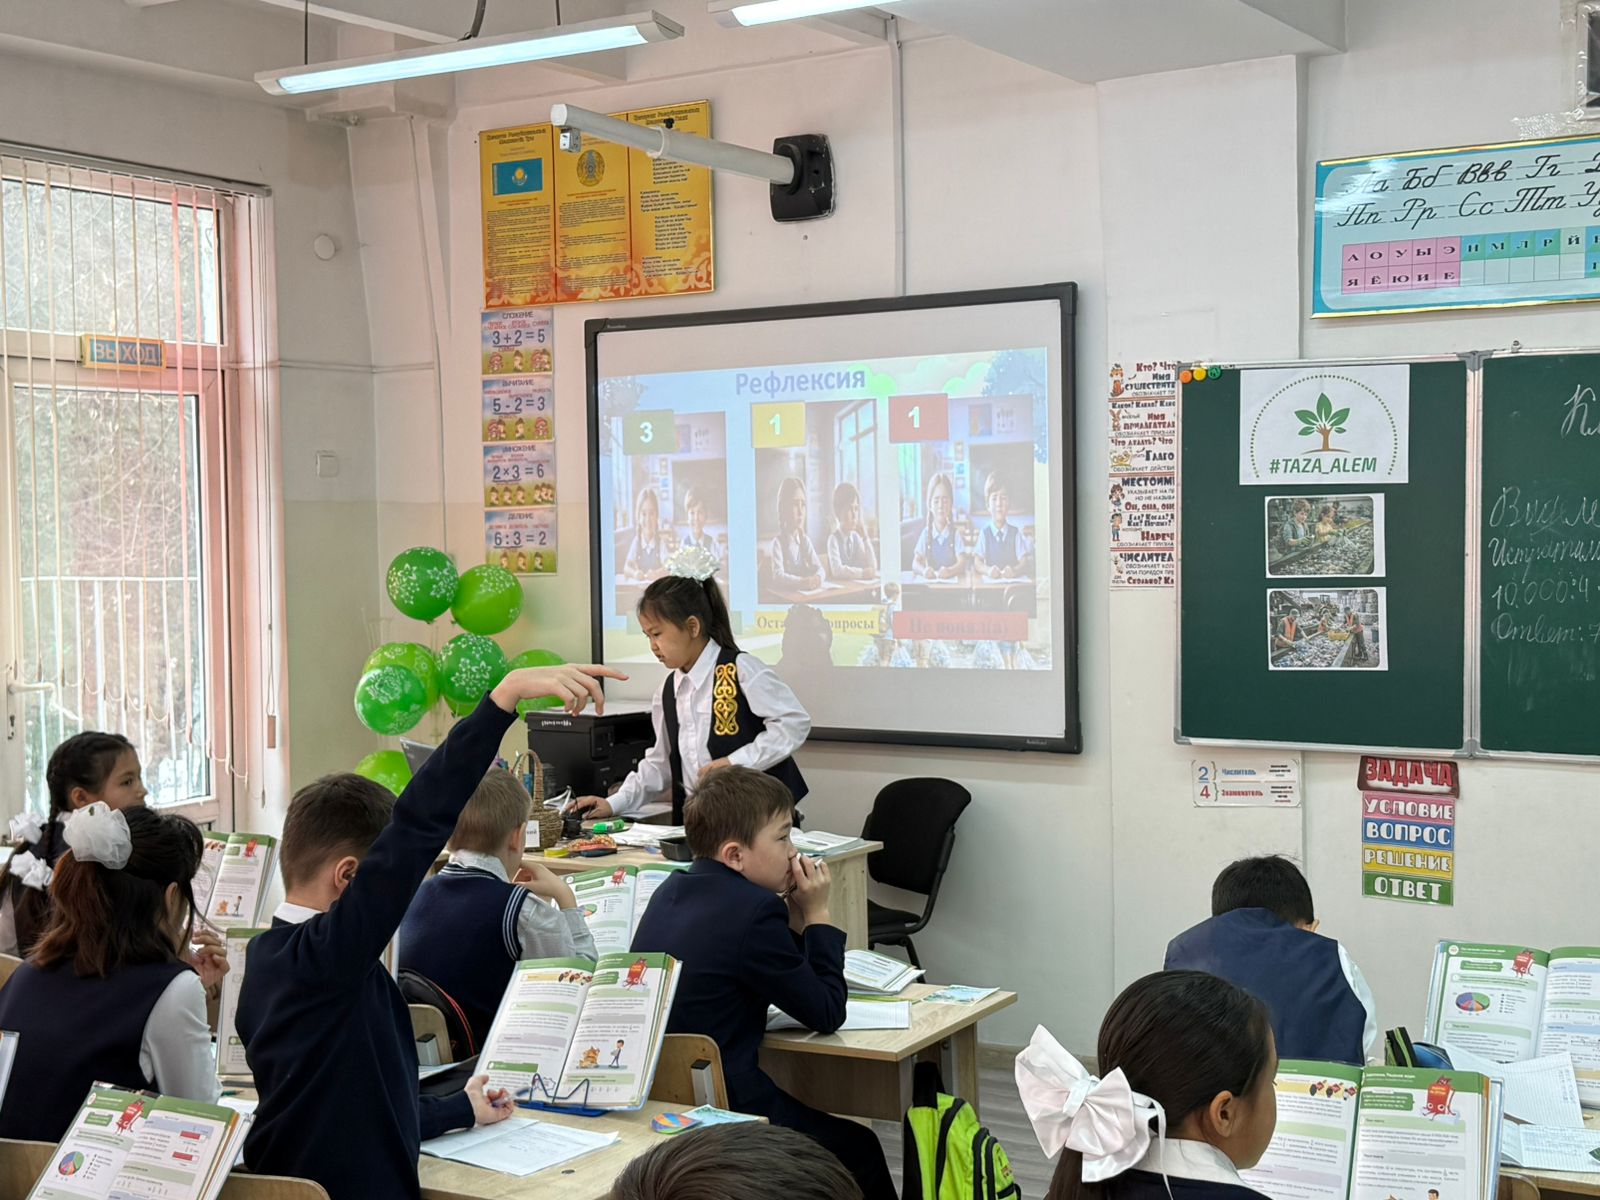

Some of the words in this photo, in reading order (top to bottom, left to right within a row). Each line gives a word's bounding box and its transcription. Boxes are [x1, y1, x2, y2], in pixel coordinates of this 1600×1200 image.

[1459, 191, 1494, 217] Сс
[1504, 185, 1566, 212] Тт
[1347, 253, 1360, 262] А
[1369, 251, 1383, 260] О
[1395, 249, 1408, 258] У
[1416, 247, 1431, 257] Ы
[1443, 245, 1456, 255] Э
[1468, 244, 1479, 252] Н
[1490, 242, 1505, 251] М
[1516, 240, 1529, 249] Л
[1543, 239, 1553, 247] Р
[1567, 234, 1580, 246] Й
[1347, 278, 1358, 287] Я
[1371, 275, 1382, 285] Ё
[1392, 274, 1409, 284] Ю
[1417, 273, 1429, 282] И
[1444, 271, 1455, 280] Е
[95, 343, 157, 364] ВЫХОД
[735, 370, 866, 398] Рефлексия
[1124, 381, 1175, 391] СУЩЕСТВИТЕ
[768, 413, 782, 436] 1
[907, 406, 921, 429] 1
[639, 421, 654, 443] 3
[1269, 457, 1377, 475] #TAZA_ALEM
[1121, 476, 1175, 487] МЕСТОИМ
[1119, 552, 1174, 562] ЧИСЛИТЕЛ
[826, 618, 875, 632] опросы
[1198, 766, 1209, 780] 2
[1366, 757, 1454, 787] ЗАДАЧА
[1200, 785, 1211, 799] 4
[1364, 798, 1454, 820] УСЛОВИЕ
[1366, 821, 1451, 845] ВОПРОС
[1364, 848, 1451, 872] РЕШЕНИЕ
[1374, 876, 1442, 901] ОТВЕТ
